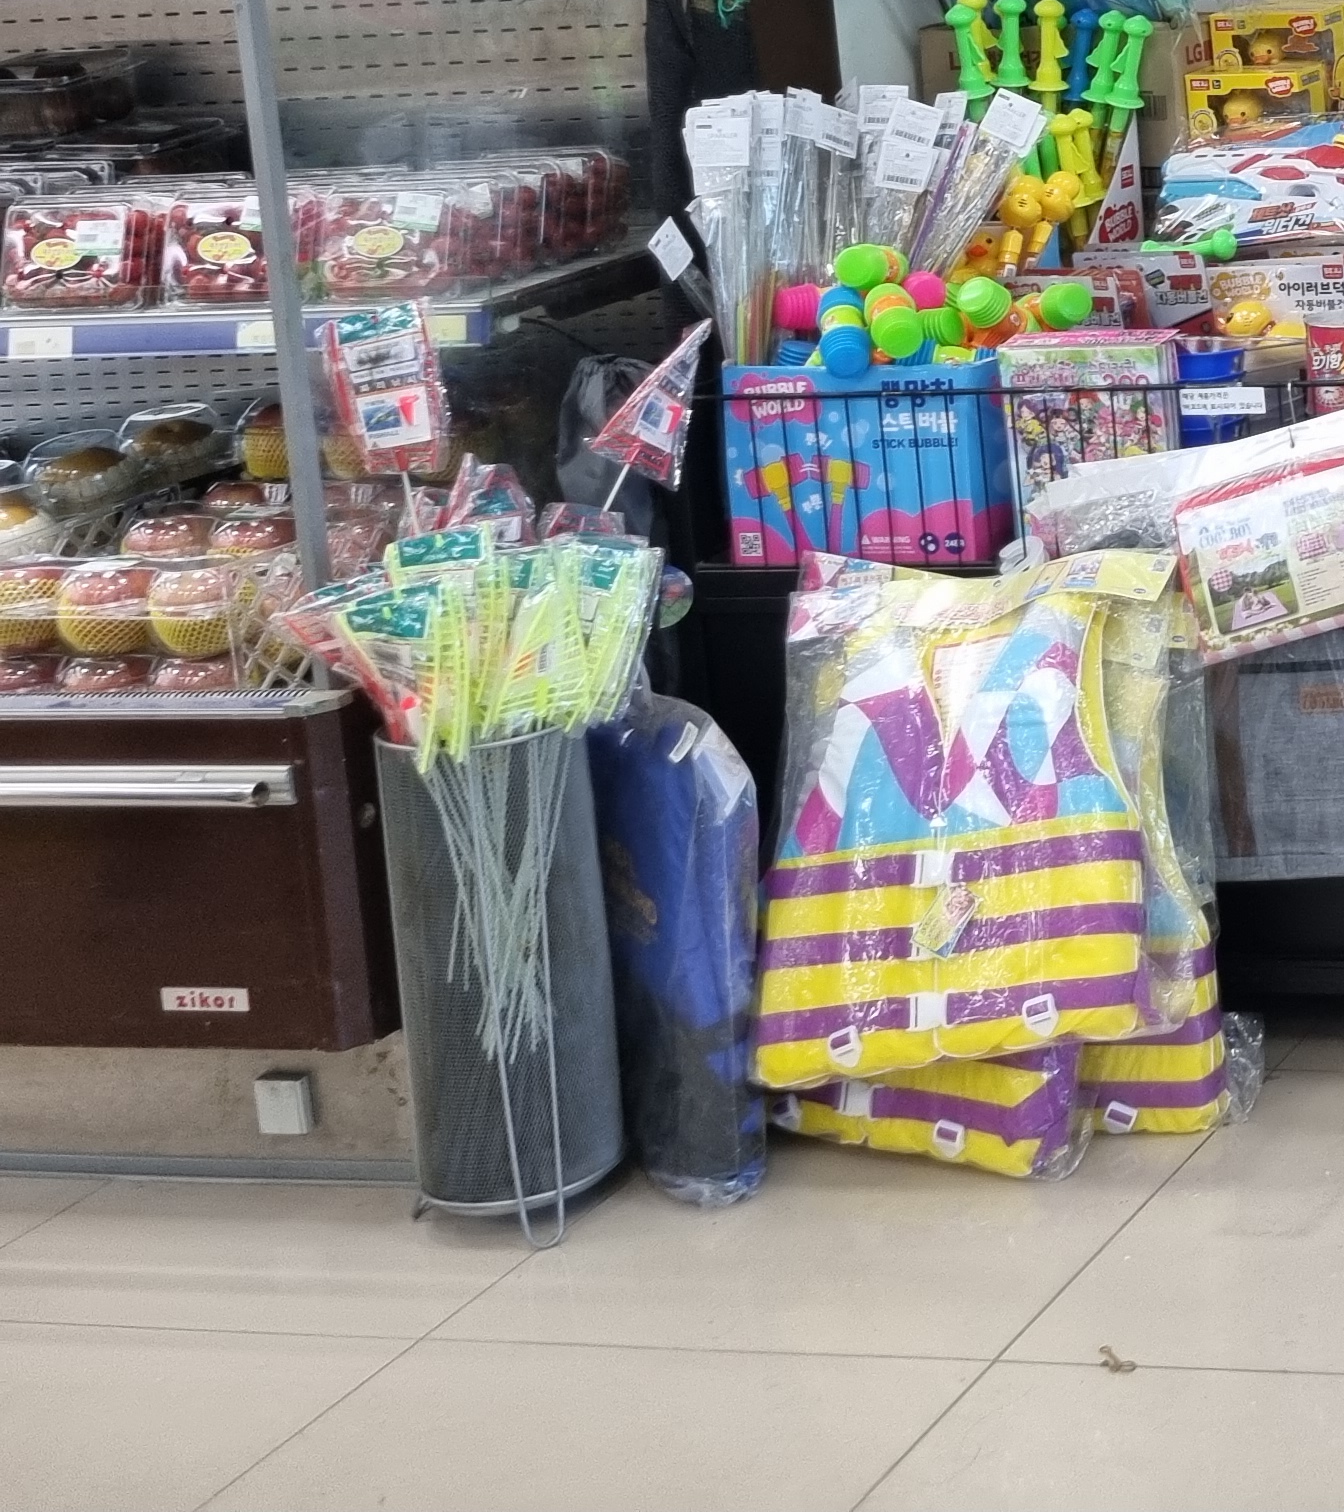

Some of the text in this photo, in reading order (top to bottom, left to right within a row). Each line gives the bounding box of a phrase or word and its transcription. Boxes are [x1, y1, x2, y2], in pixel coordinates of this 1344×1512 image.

[1104, 205, 1134, 231] BUBBLE
[1261, 212, 1315, 236] 워터건
[1219, 273, 1265, 289] BUBBLE
[1155, 289, 1209, 306] 자동버블건
[1225, 285, 1262, 299] WORLD
[1311, 352, 1343, 372] 모기향
[752, 397, 806, 420] WORLD
[871, 437, 906, 450] STICK
